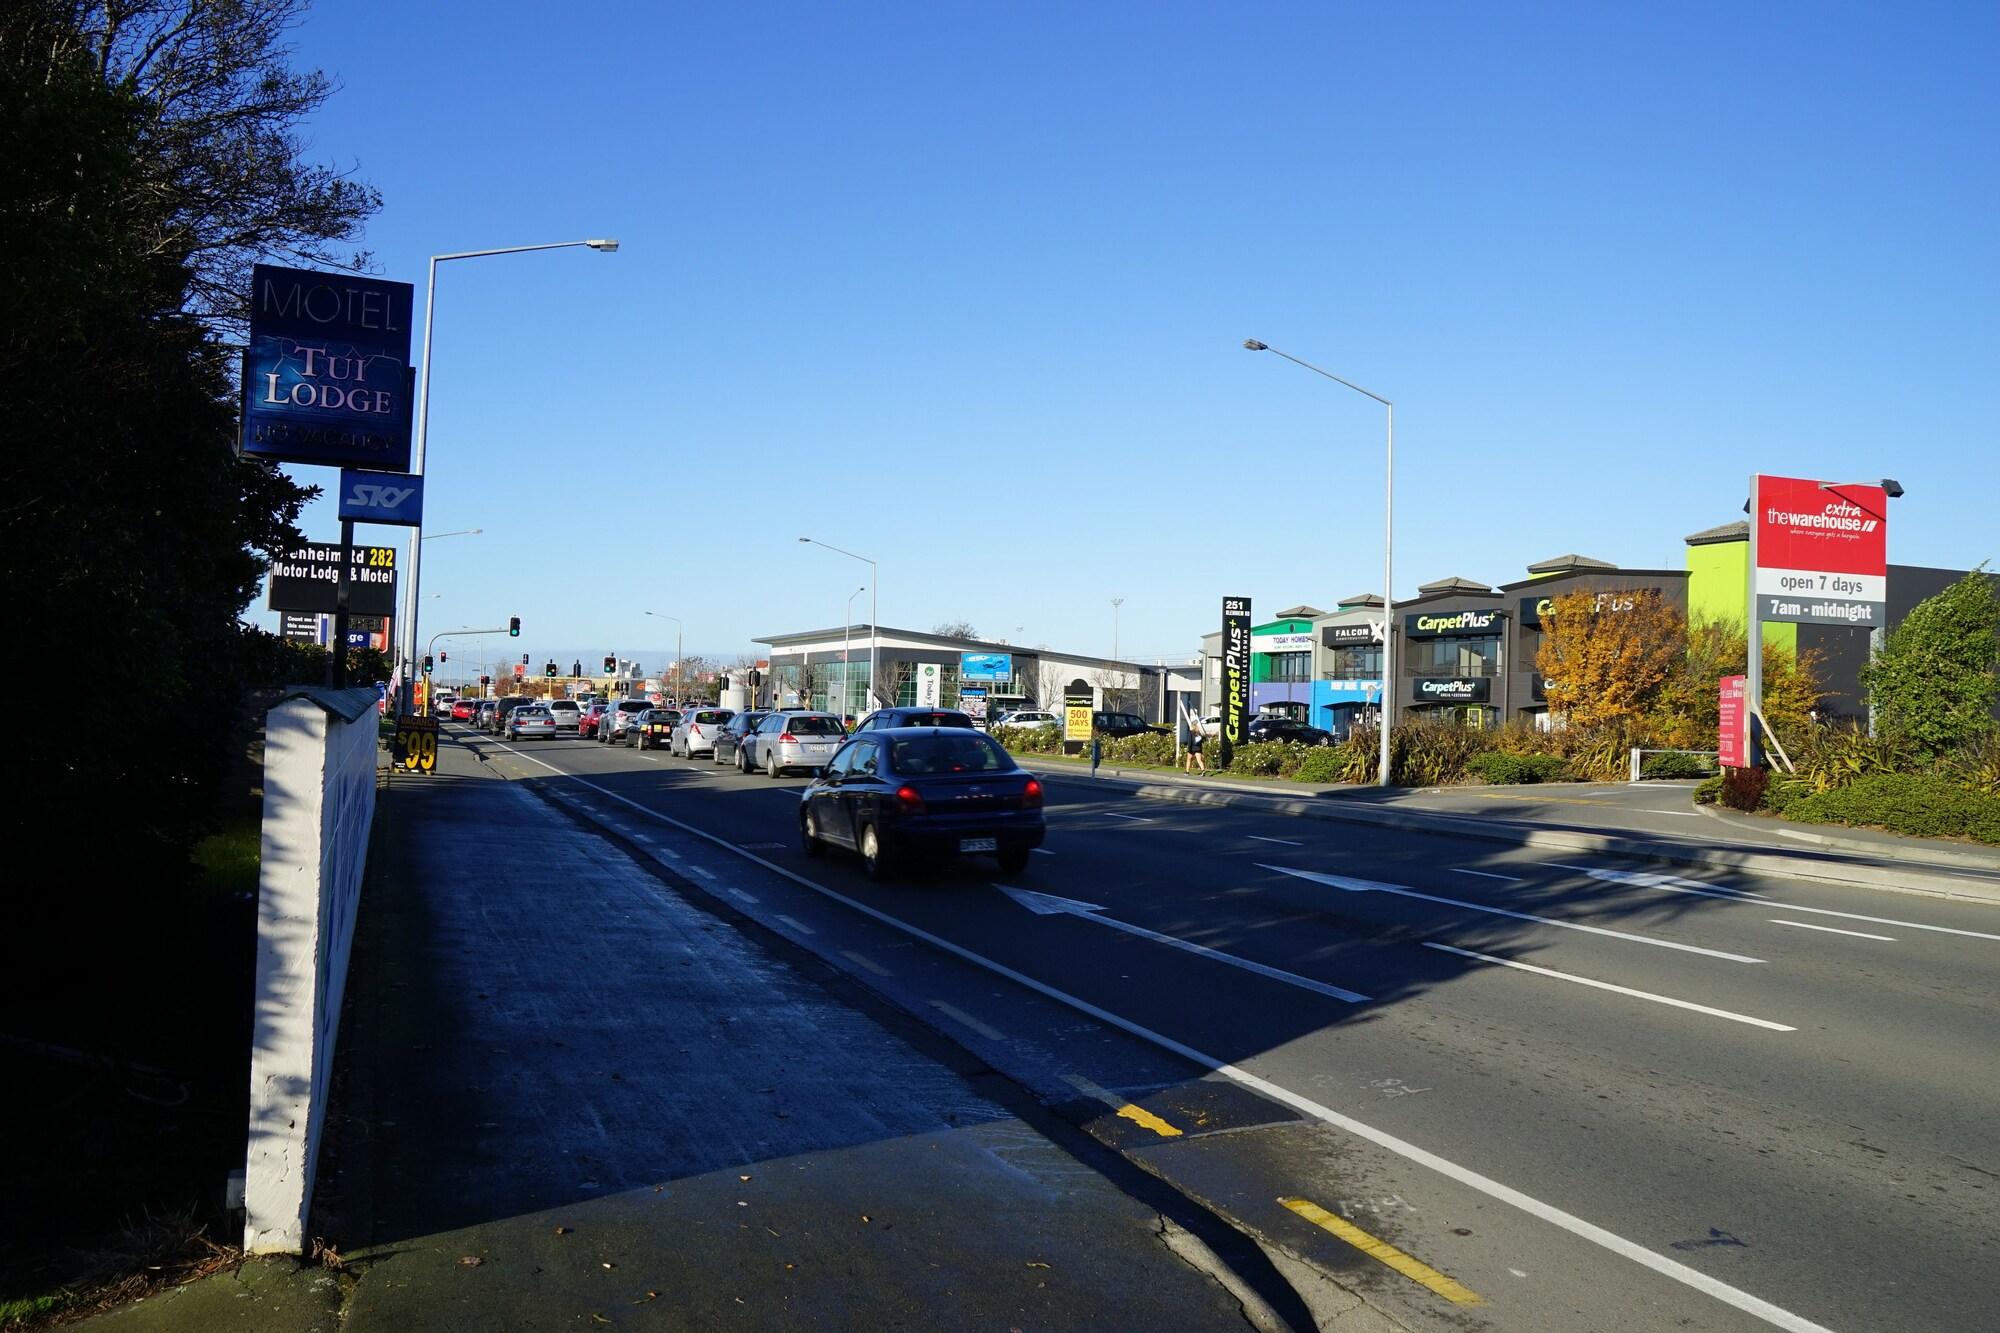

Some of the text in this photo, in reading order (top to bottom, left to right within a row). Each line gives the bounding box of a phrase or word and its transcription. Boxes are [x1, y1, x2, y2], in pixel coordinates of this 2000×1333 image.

[263, 278, 400, 331] MOTEL
[346, 484, 416, 509] SKY
[1826, 500, 1863, 517] extra
[280, 547, 341, 562] enheim
[369, 548, 393, 567] 282
[273, 562, 392, 584] Motor Lodg & Motel
[1780, 575, 1863, 594] open 7 days
[1226, 601, 1243, 610] 251
[1770, 600, 1800, 616] 7am
[1811, 601, 1872, 621] midnight
[1273, 636, 1289, 644] TODAY
[1335, 628, 1369, 637] FALCON
[925, 679, 934, 700] Today
[1068, 719, 1089, 727] DAYS
[1070, 709, 1087, 719] 500
